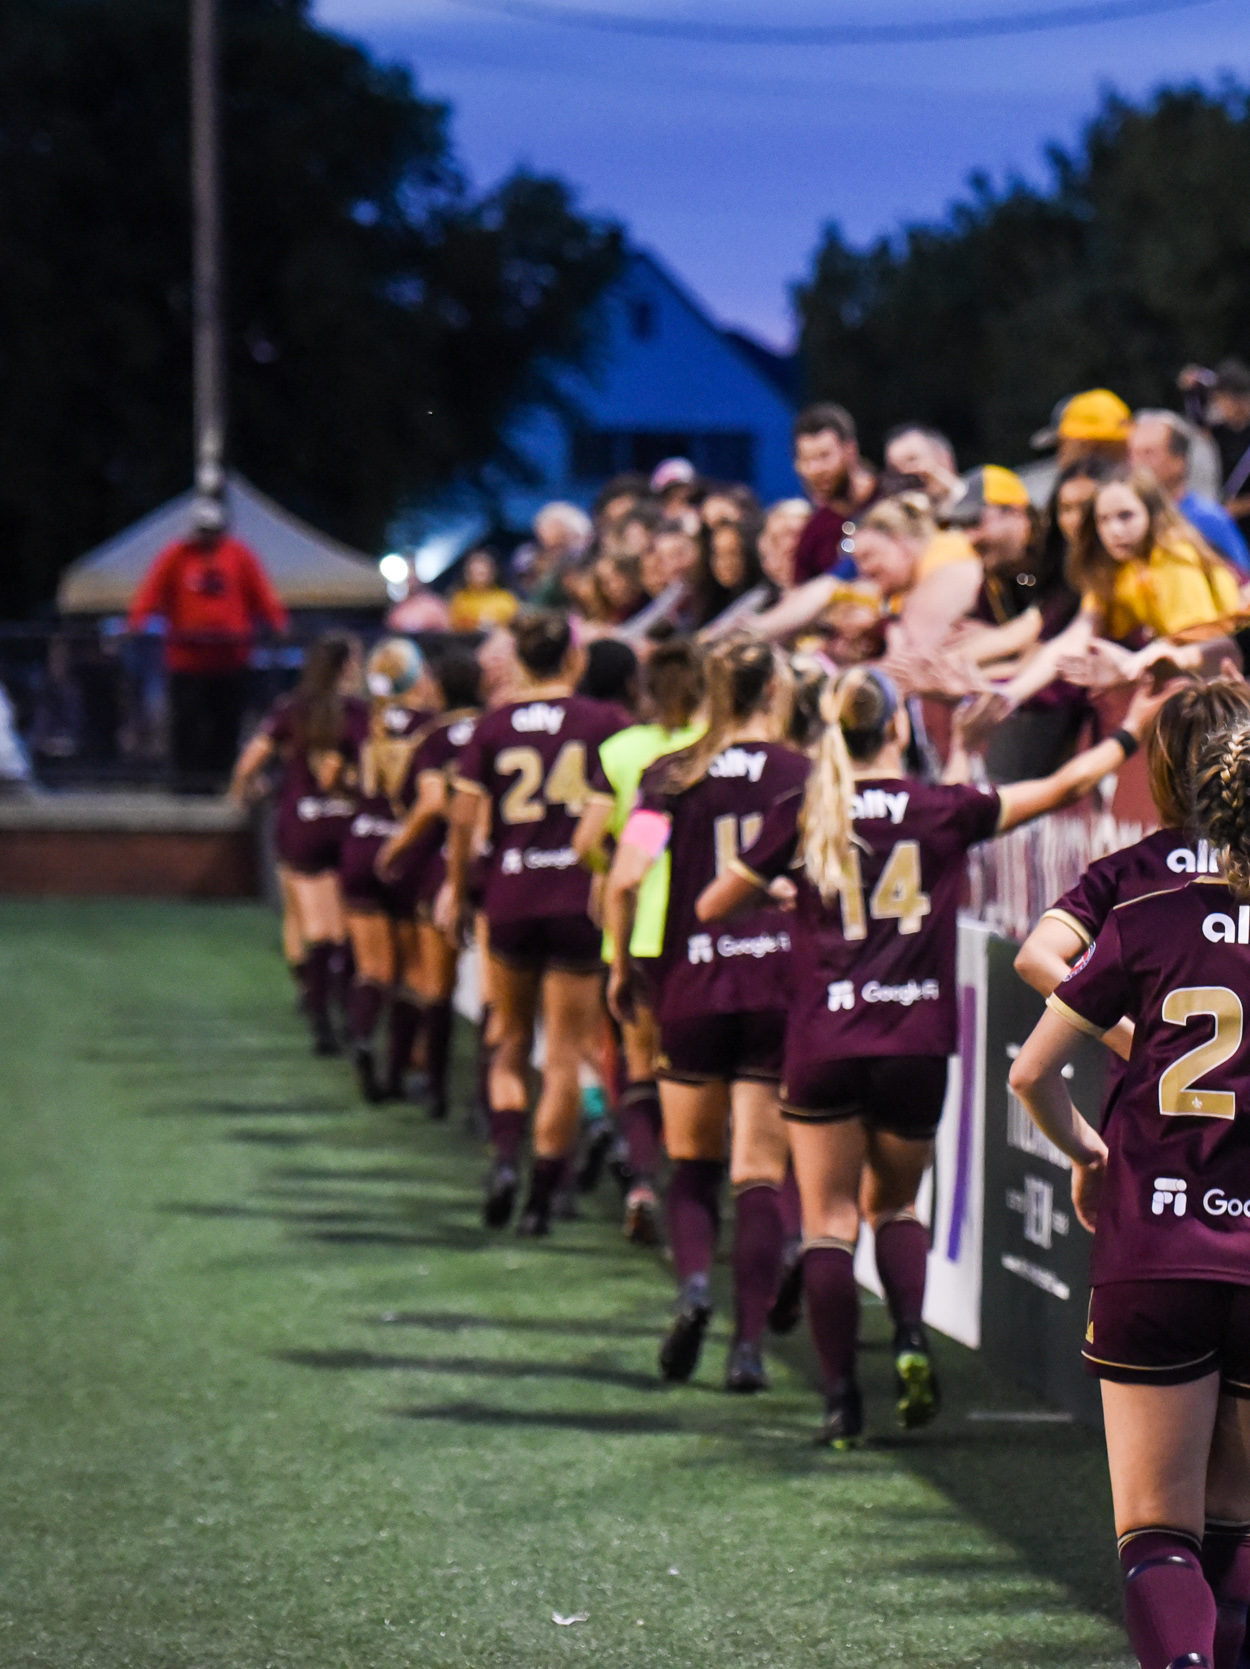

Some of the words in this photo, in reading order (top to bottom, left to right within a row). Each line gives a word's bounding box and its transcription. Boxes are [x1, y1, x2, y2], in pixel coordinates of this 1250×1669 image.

[494, 739, 588, 825] 24
[838, 838, 931, 941] 14
[1166, 838, 1221, 874] all
